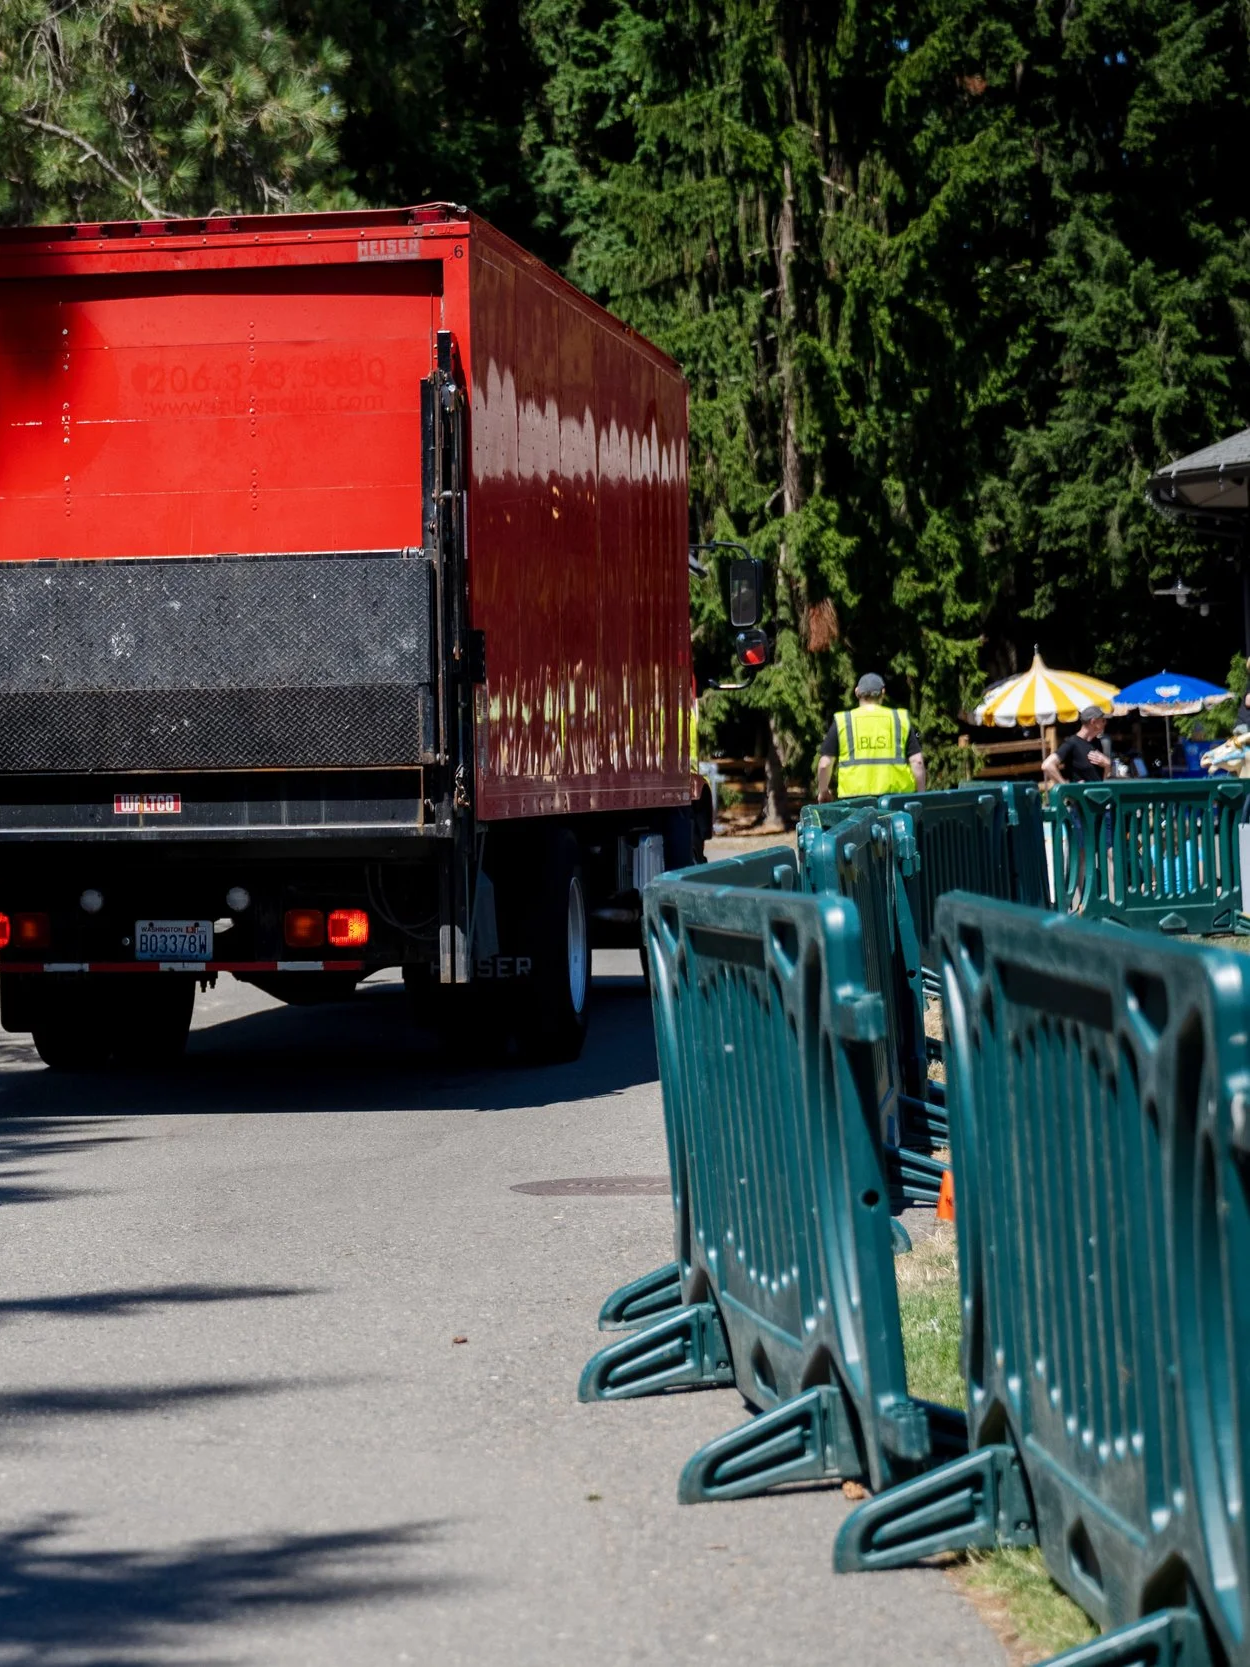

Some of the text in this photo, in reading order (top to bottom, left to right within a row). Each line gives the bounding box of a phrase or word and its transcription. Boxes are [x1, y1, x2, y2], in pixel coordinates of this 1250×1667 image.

[357, 238, 420, 256] HEISER
[860, 736, 886, 750] BLS
[120, 795, 174, 812] WALTCO
[140, 934, 207, 954] B03378W
